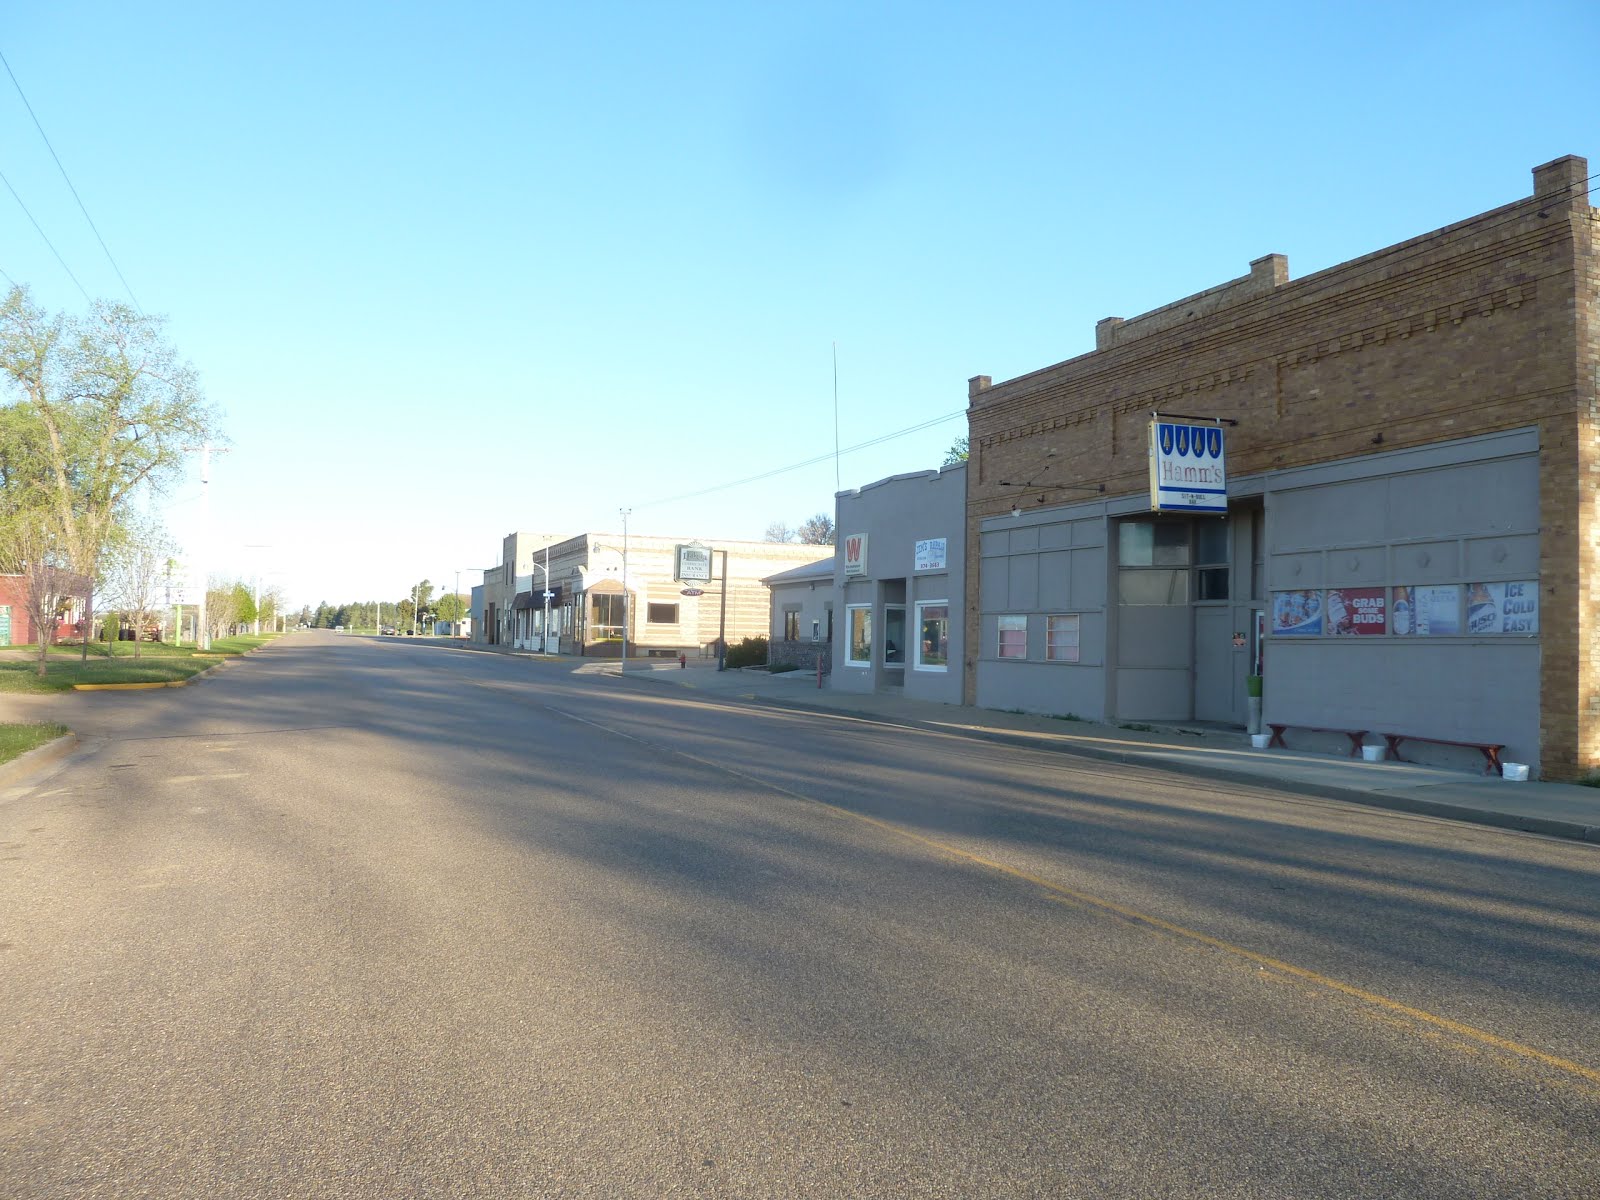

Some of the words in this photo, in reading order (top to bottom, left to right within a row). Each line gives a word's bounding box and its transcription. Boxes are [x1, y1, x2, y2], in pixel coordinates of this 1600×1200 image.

[1162, 460, 1222, 483] Hamm's
[1504, 583, 1524, 598] ICE
[1352, 598, 1385, 608] GRAB
[1503, 599, 1535, 615] COLD
[1352, 614, 1385, 624] BUDS
[1502, 617, 1533, 632] EASY
